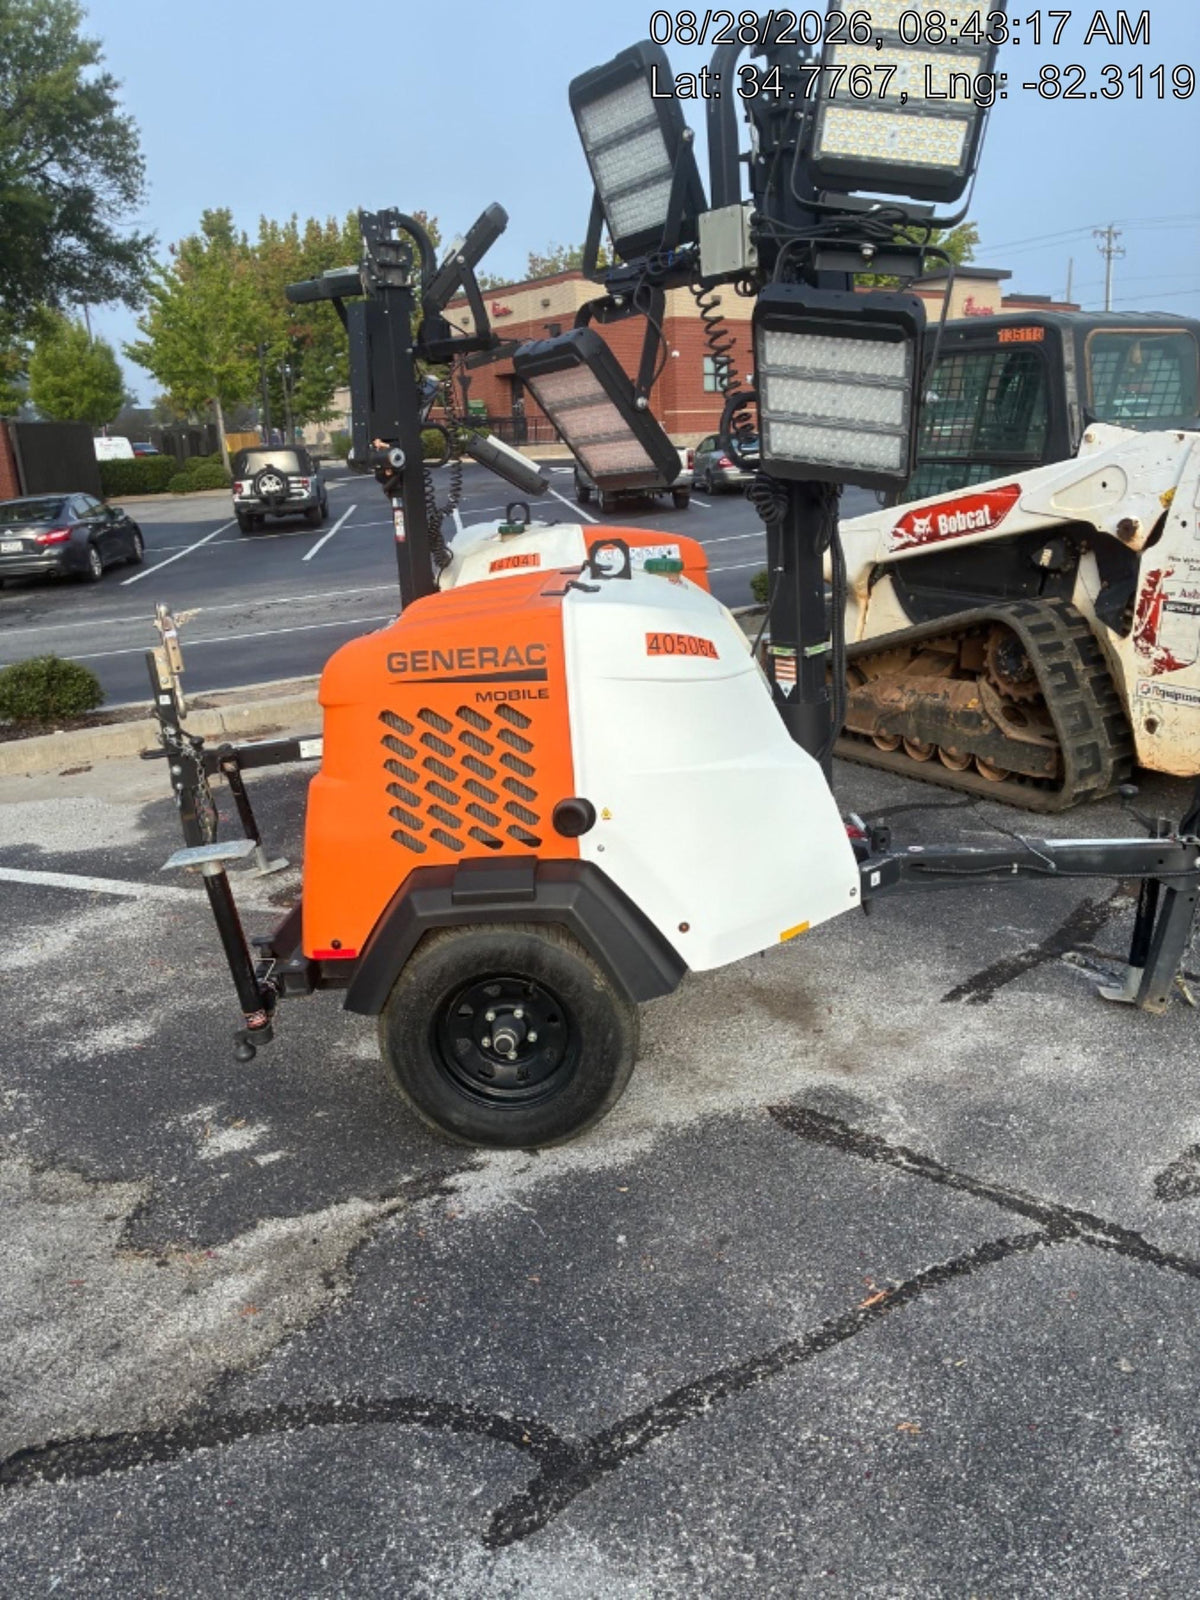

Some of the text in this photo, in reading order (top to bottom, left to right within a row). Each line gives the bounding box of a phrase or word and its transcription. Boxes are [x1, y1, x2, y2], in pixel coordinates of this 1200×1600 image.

[937, 504, 992, 536] Bobcat
[387, 643, 547, 674] GENERAC
[475, 688, 550, 703] MOBILE
